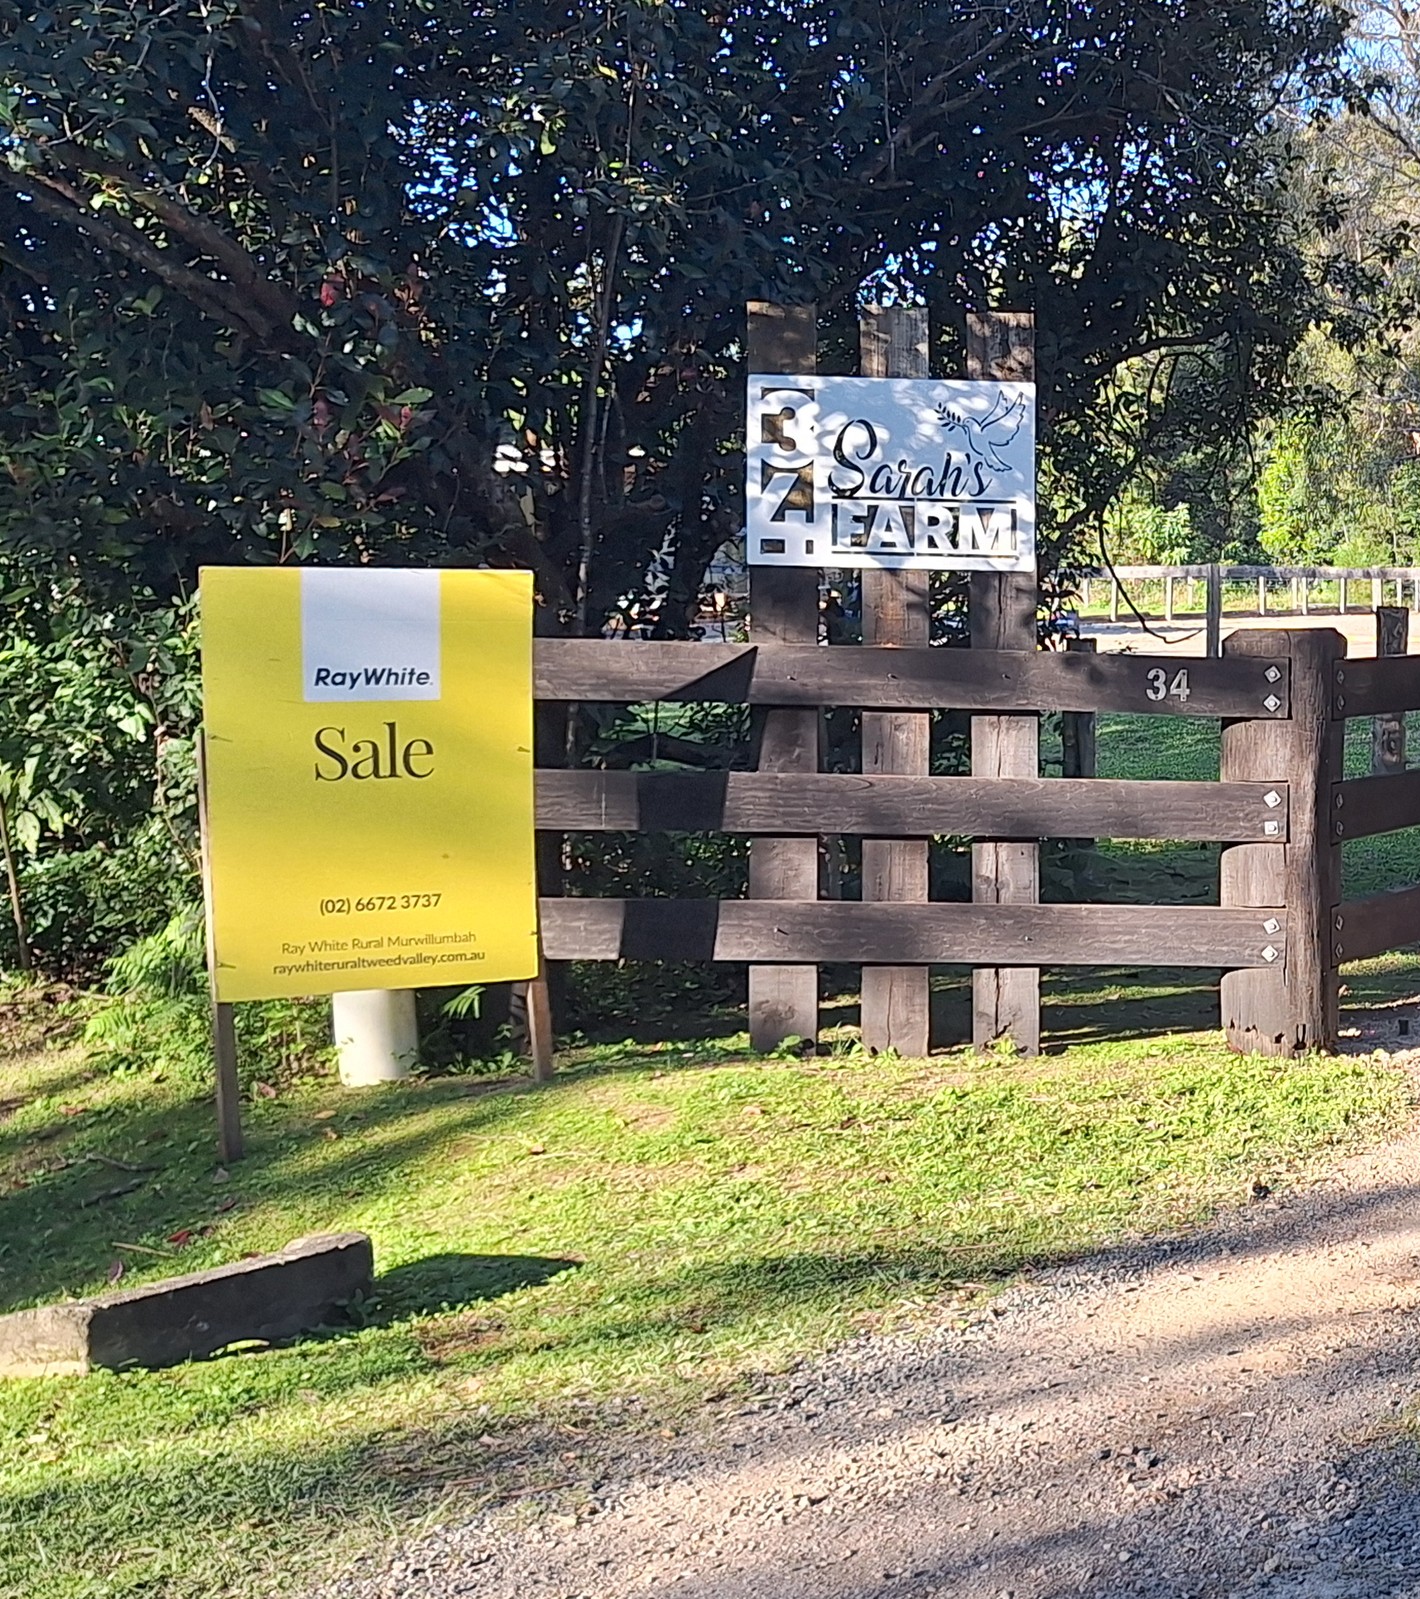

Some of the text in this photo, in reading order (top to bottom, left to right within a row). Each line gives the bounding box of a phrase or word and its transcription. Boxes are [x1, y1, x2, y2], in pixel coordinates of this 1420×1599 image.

[828, 418, 992, 498] Sarah's
[836, 504, 1016, 552] FARM
[1146, 668, 1190, 701] 34
[314, 721, 434, 781] Sale
[319, 893, 442, 916] (02) 6672 3737
[282, 931, 477, 957] Ray White Rural Murwillumbah
[273, 950, 486, 976] raywhiteruraltweedvalley.com.au
